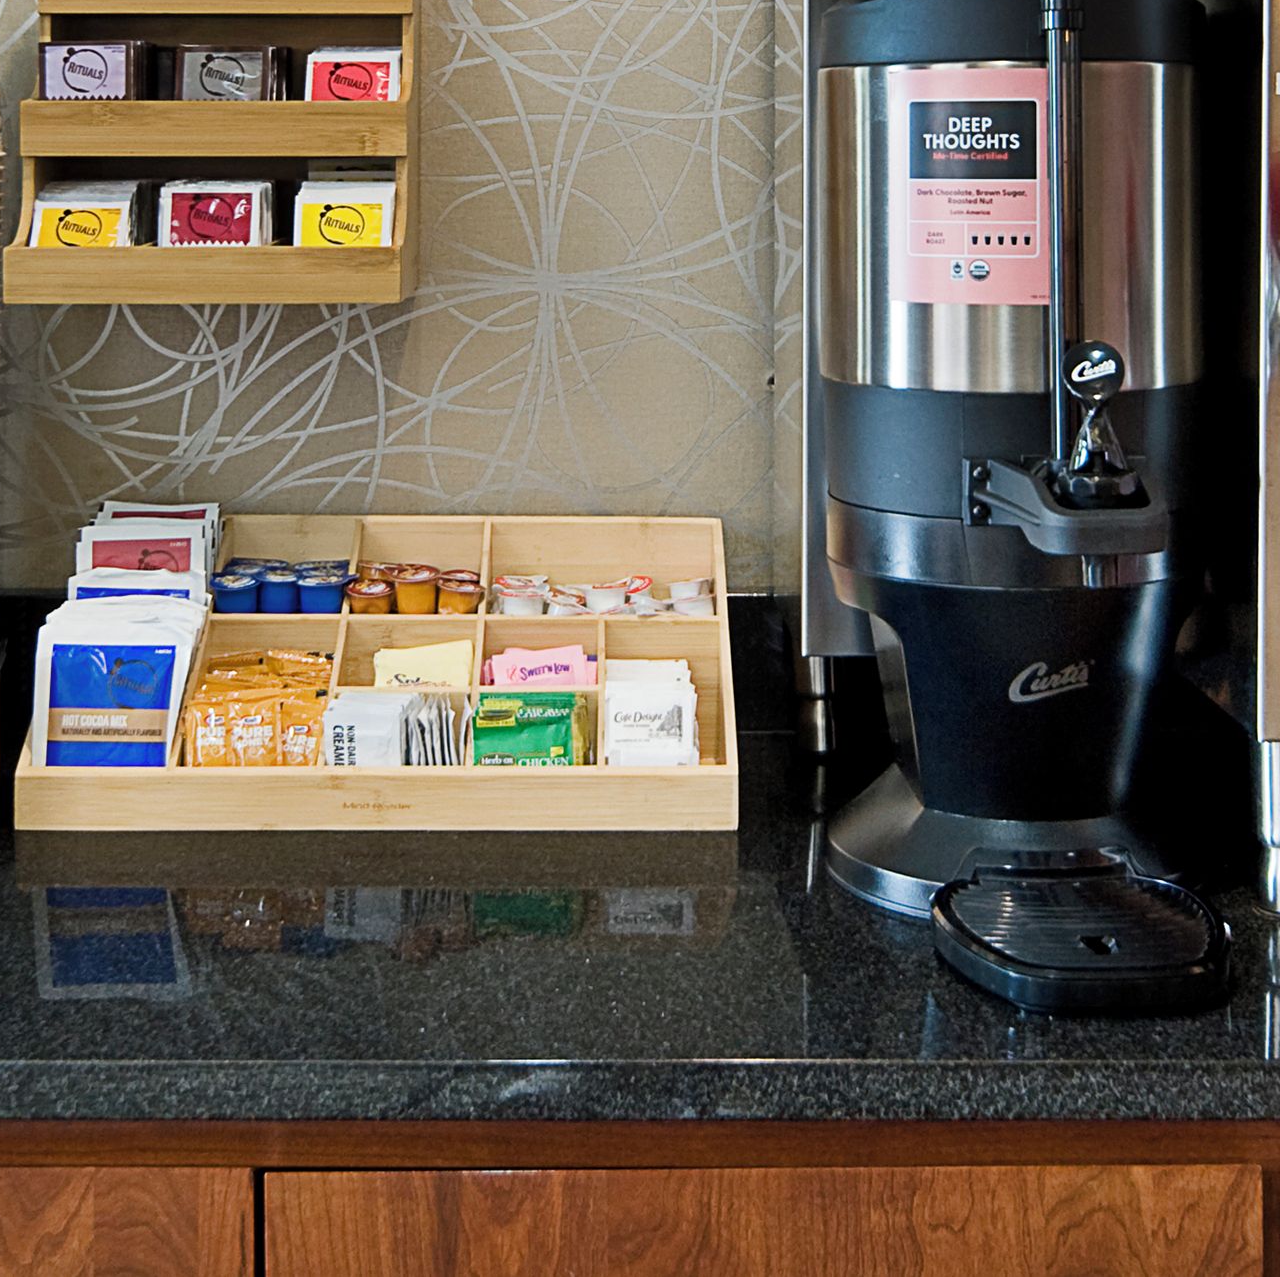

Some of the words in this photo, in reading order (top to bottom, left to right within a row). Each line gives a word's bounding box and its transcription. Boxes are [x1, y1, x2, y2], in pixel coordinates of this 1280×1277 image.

[948, 117, 993, 133] DEEP
[923, 134, 1020, 150] THOUGHTS
[971, 152, 1008, 160] Certified
[936, 189, 975, 197] Chocolate,
[976, 189, 1001, 197] Brown
[1003, 189, 1028, 198] Sugar,
[1009, 661, 1090, 702] Curtis
[62, 715, 79, 726] HOT
[81, 715, 110, 726] COCOA
[111, 715, 128, 727] MIX
[232, 725, 272, 738] PURE
[333, 724, 345, 766] CREAME
[347, 725, 356, 766] NON-DAIR
